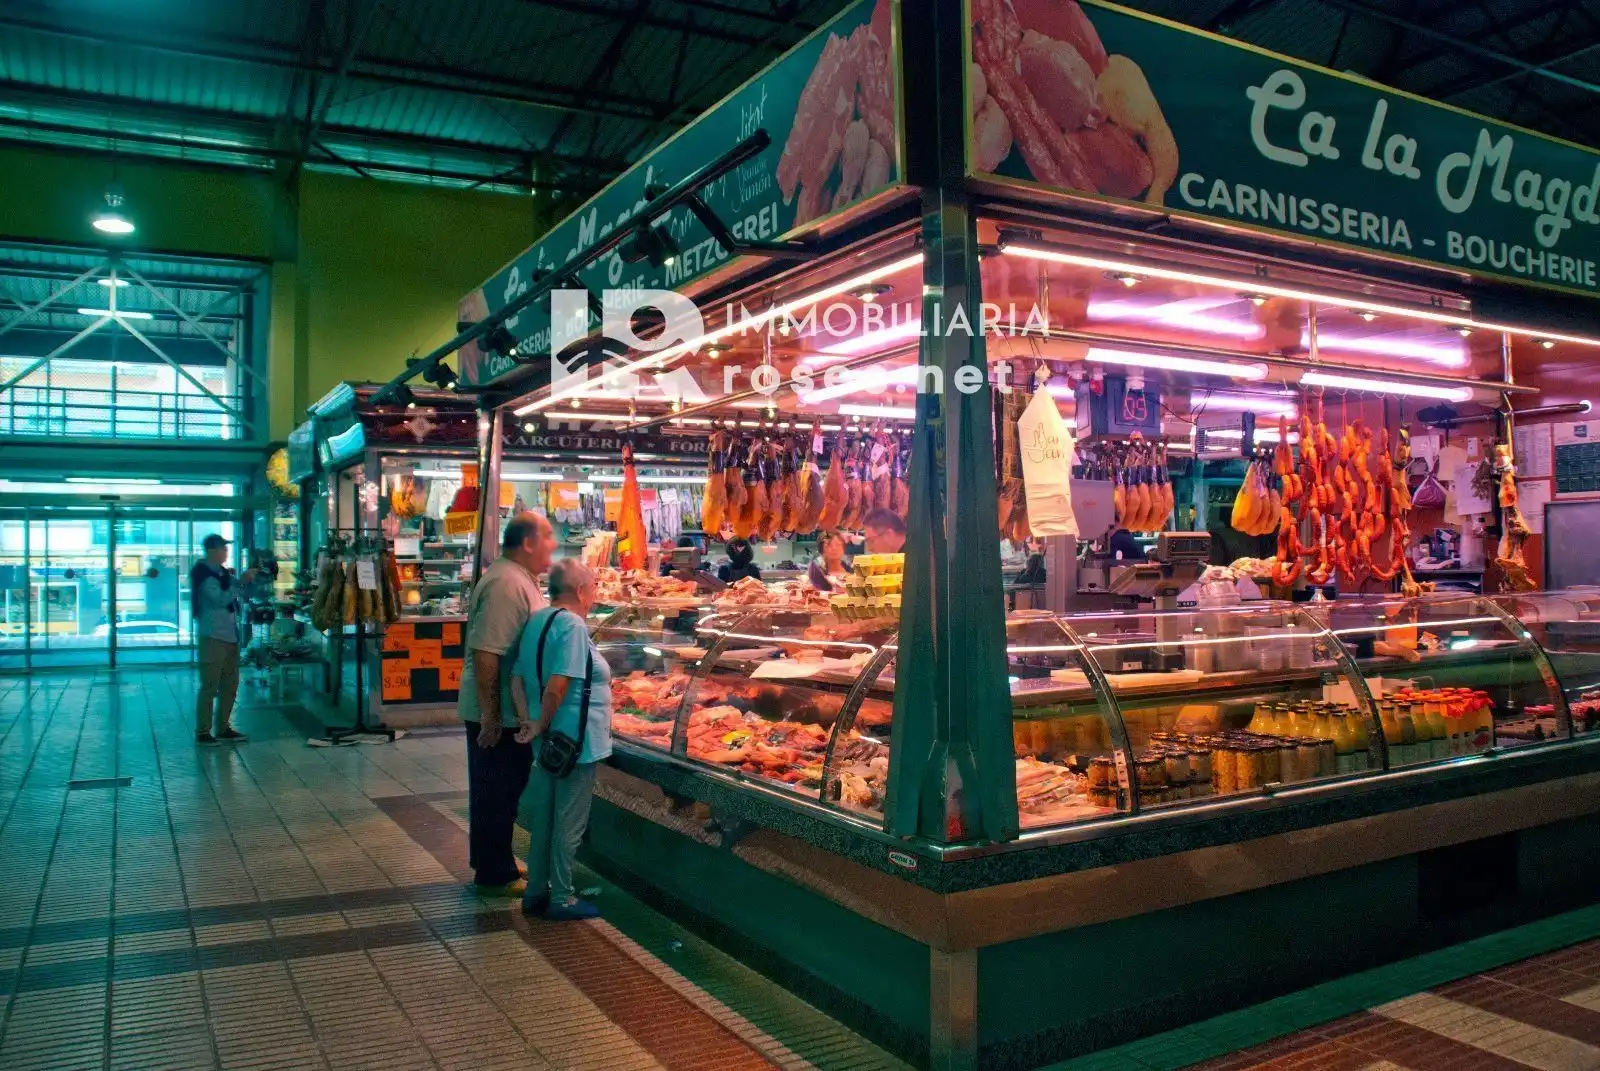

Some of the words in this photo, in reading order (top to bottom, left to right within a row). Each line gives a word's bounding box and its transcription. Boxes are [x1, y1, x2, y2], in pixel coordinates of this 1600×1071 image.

[1245, 68, 1340, 167] Ca
[1361, 97, 1421, 180] la
[1178, 171, 1413, 251] CARNISSERIA
[1445, 230, 1597, 287] BOUCHERIE
